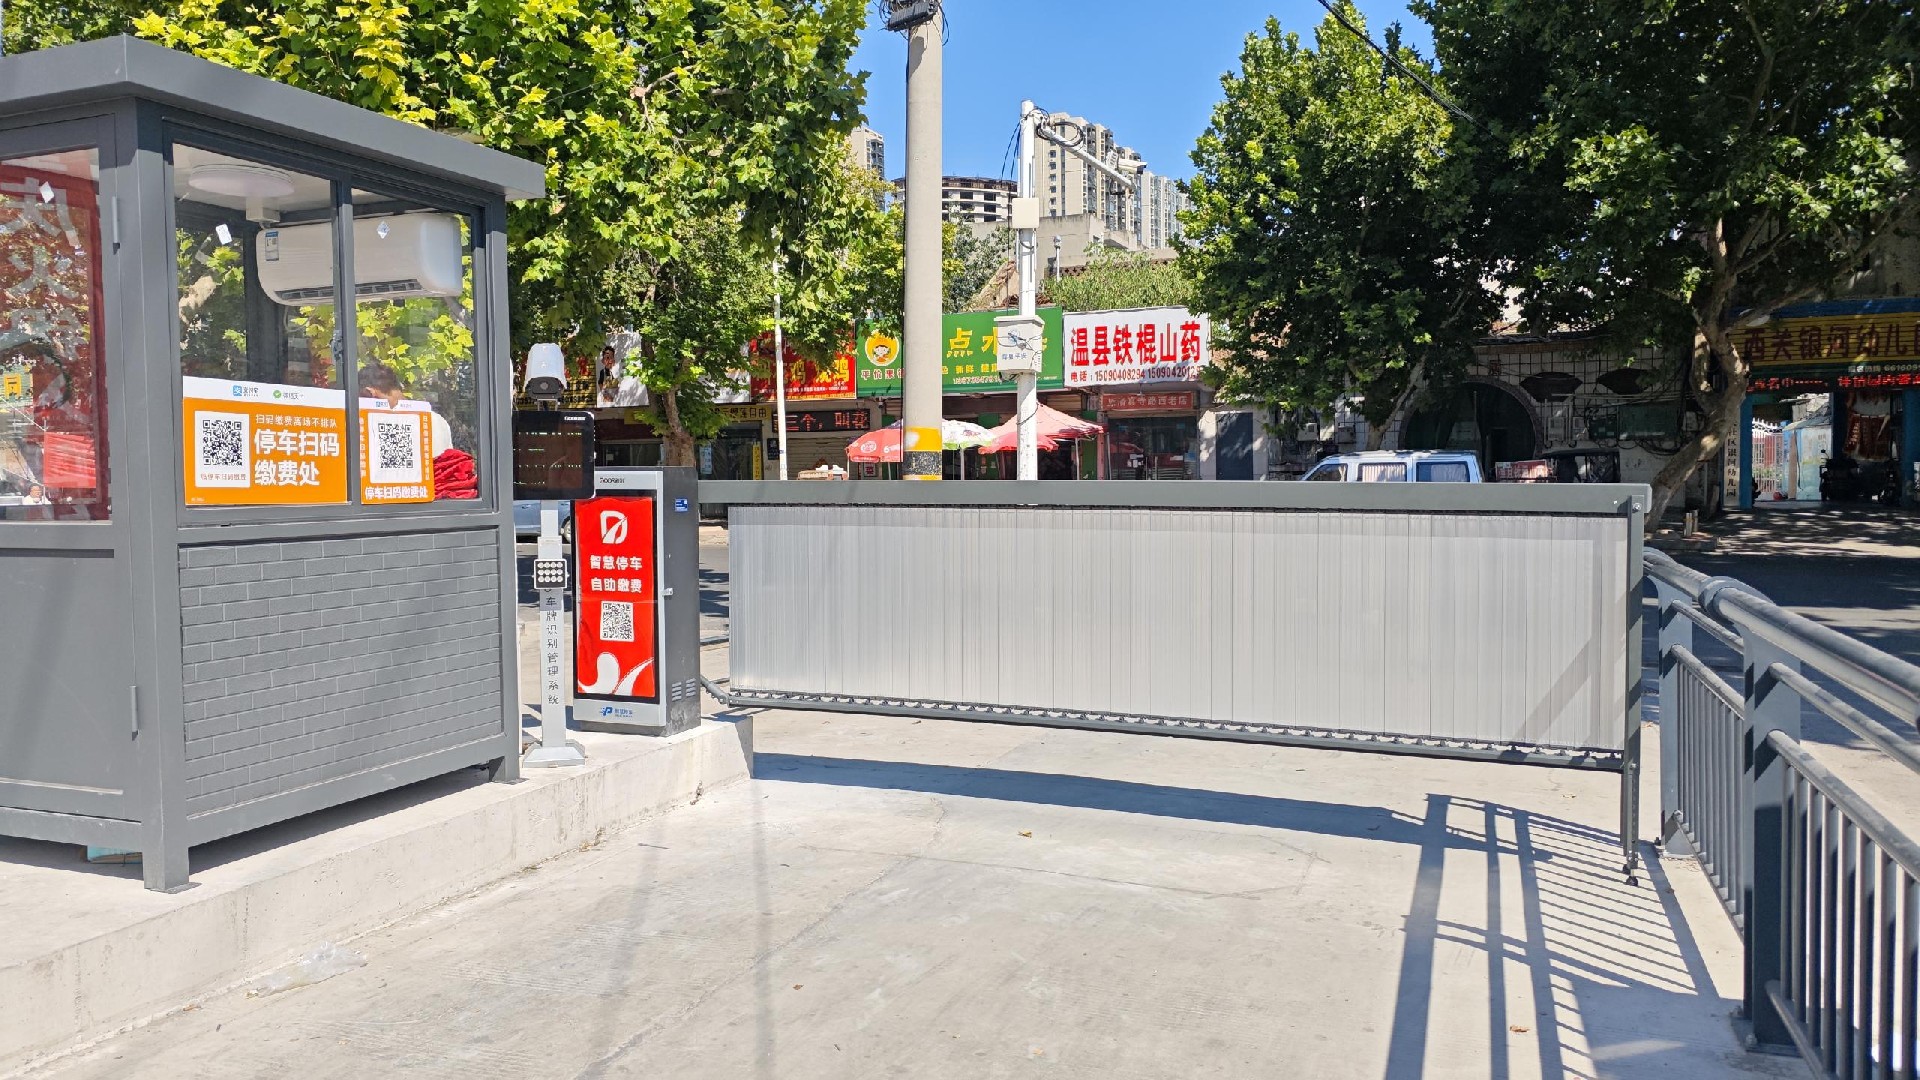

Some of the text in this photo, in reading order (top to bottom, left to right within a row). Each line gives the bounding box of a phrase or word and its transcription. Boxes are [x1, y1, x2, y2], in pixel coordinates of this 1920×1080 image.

[1070, 320, 1201, 367] 温县铁棍山药
[1743, 323, 1920, 361] 西关银河幼儿
[255, 413, 338, 429] 扫码缴费离场不排队
[254, 428, 341, 458] 停车扫码
[254, 460, 321, 487] 缴费处
[1726, 423, 1737, 498] 社区银河幼儿园
[364, 485, 429, 500] 停车扫码缴费处
[589, 554, 643, 571] 智慧停车
[590, 577, 643, 594] 自助缴费
[545, 588, 559, 705] 车牌识别管理系统
